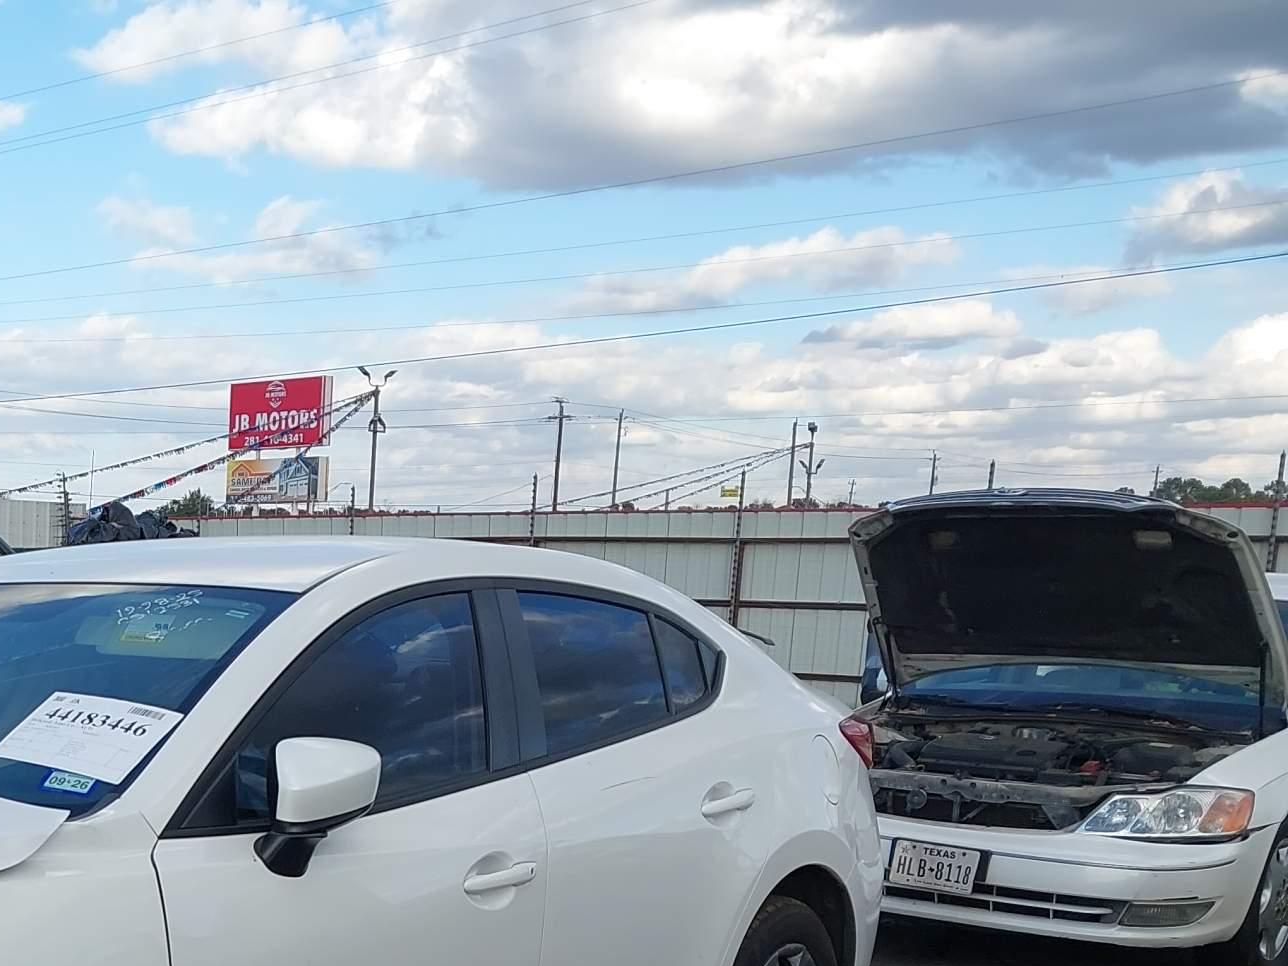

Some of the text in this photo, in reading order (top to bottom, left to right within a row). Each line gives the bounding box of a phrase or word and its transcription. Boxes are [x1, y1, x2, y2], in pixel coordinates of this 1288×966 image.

[233, 408, 318, 433] JB MOTORS
[45, 706, 152, 738] 44183446
[48, 775, 90, 790] 09 26
[923, 847, 956, 860] TEXAS
